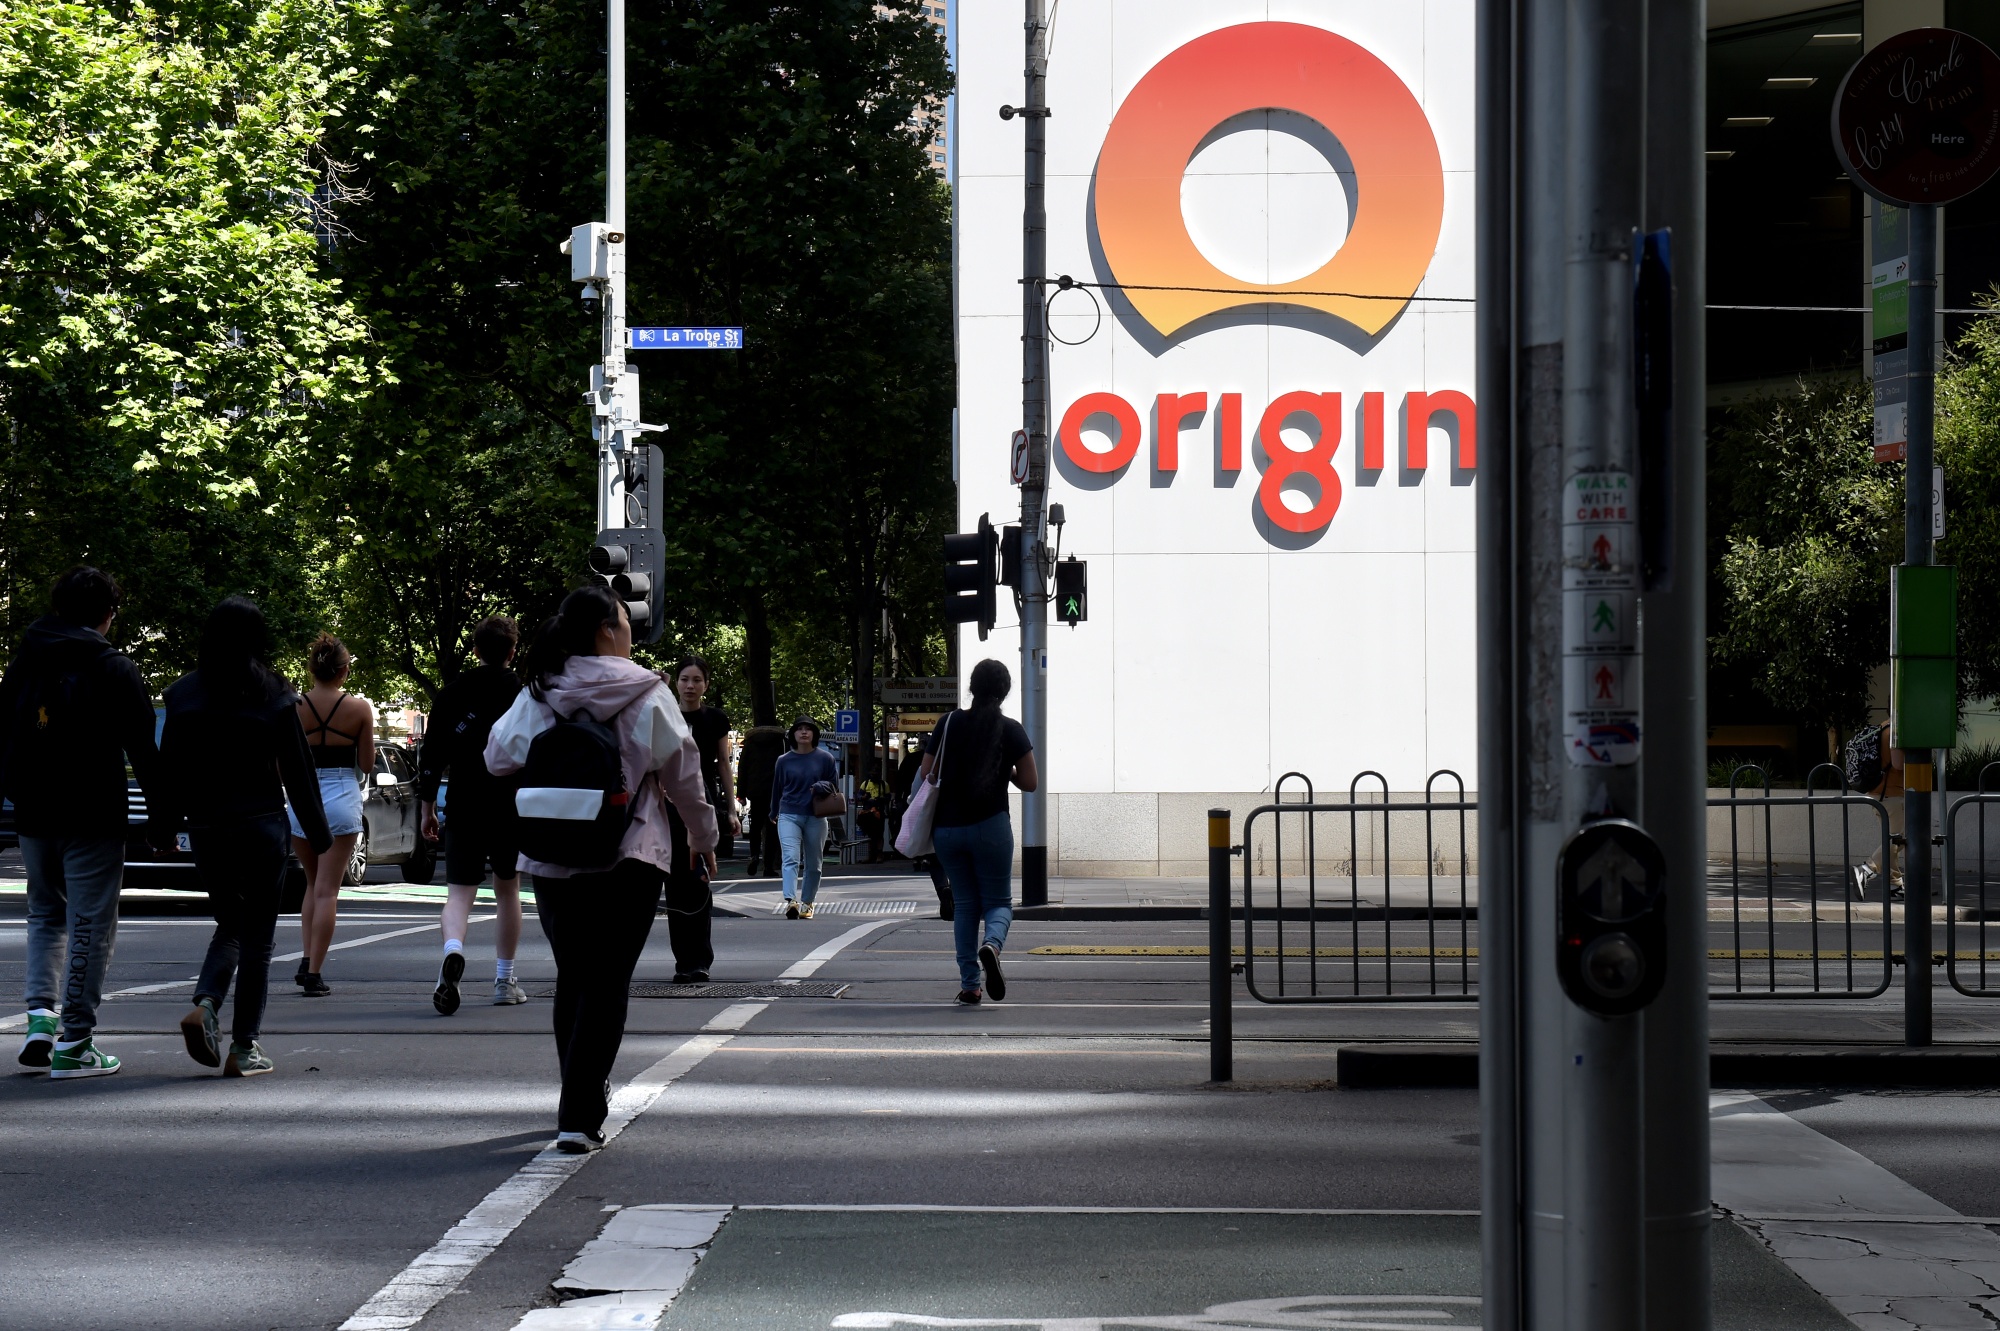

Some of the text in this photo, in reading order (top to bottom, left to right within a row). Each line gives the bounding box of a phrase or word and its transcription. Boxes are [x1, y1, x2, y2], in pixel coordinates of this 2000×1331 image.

[1888, 33, 1964, 104] Circle
[1924, 86, 1974, 111] Tram
[1931, 133, 1965, 144] Here
[1930, 170, 1951, 183] free
[664, 329, 739, 342] La Trobe St
[1874, 361, 1883, 375] 30
[1875, 387, 1883, 402] 35
[1060, 390, 1477, 533] origin
[1576, 476, 1627, 489] WALK
[1580, 492, 1622, 504] WITH
[1577, 507, 1627, 520] CARE
[841, 714, 853, 730] P
